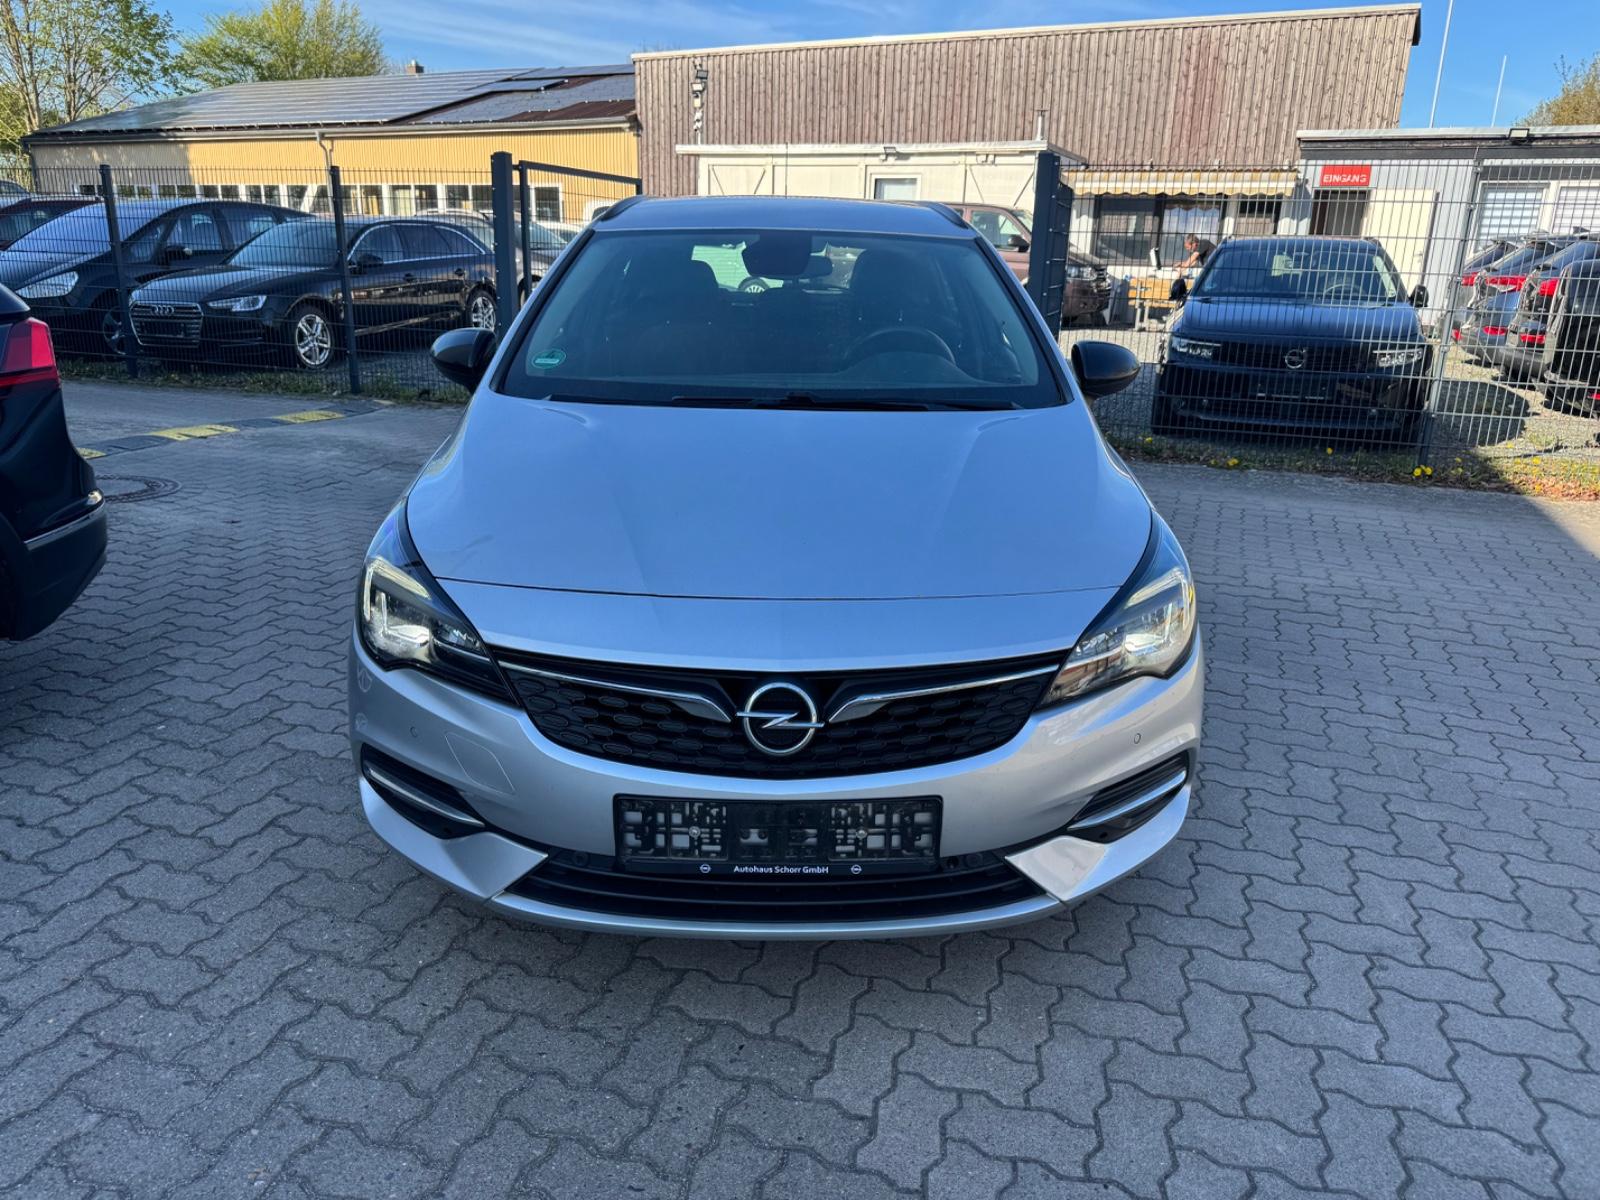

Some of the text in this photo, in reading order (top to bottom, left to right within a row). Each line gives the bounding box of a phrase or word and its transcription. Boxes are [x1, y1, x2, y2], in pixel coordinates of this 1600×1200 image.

[1323, 174, 1367, 183] EINGANG
[733, 865, 829, 874] Autohaus Schorr GmbH
